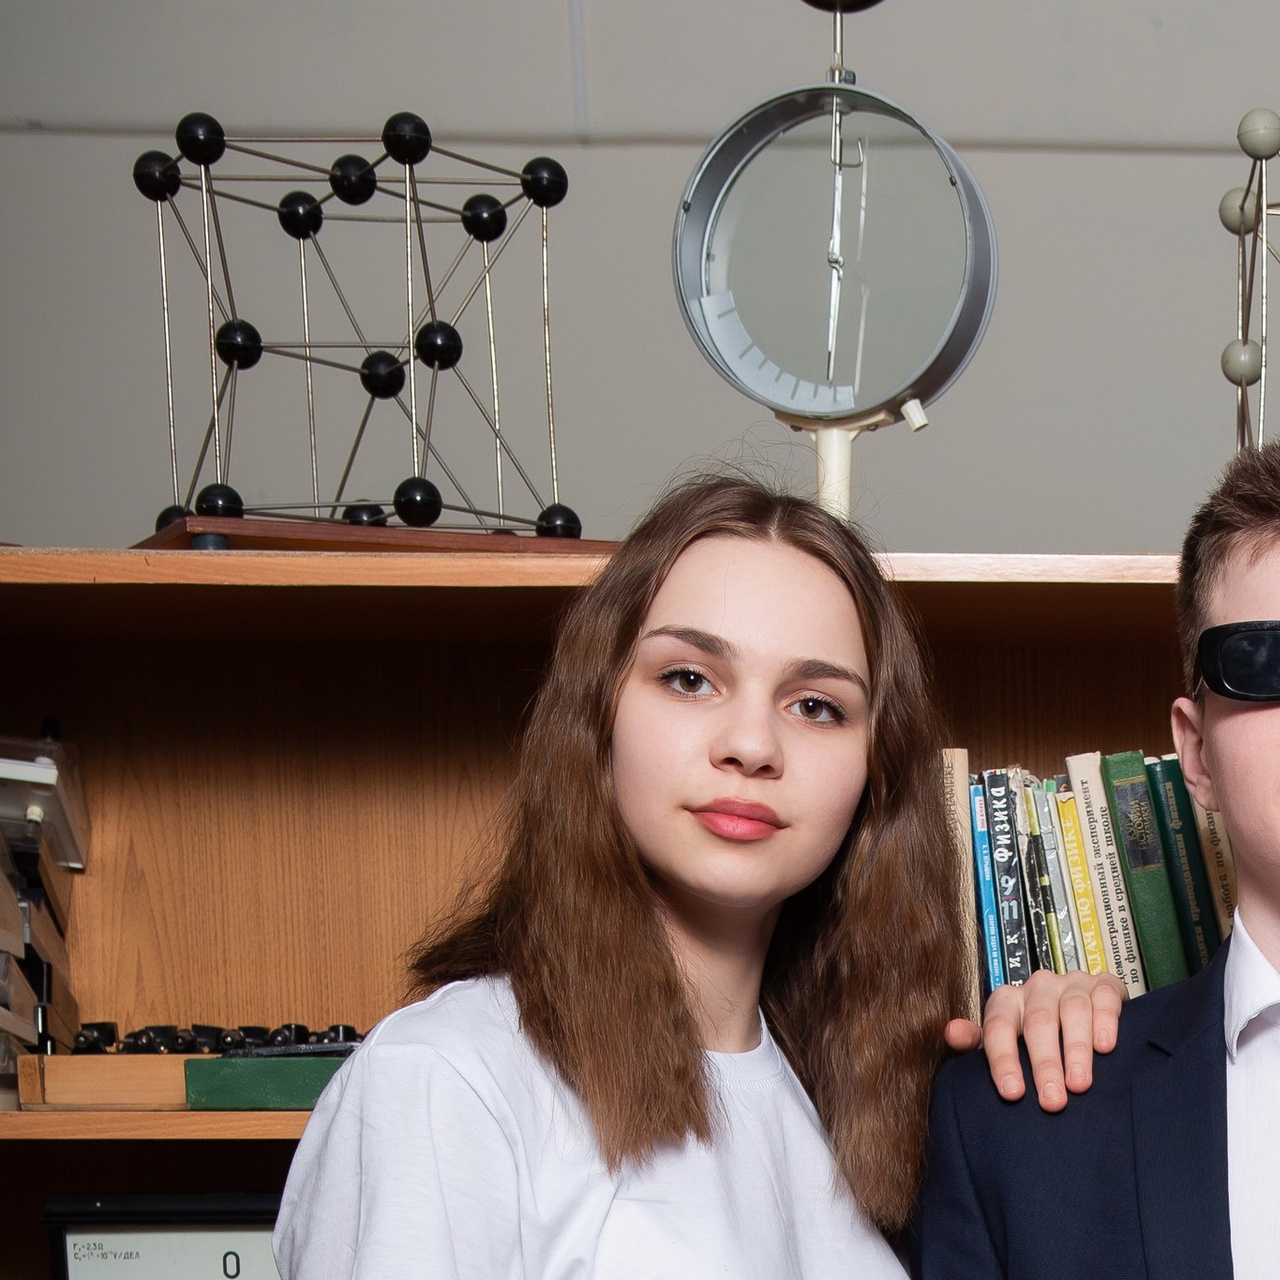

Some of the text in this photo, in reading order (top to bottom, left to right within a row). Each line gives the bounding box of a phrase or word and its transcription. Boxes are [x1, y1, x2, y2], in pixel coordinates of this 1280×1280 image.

[1080, 780, 1102, 858] эксперимент
[1063, 819, 1087, 892] ФИЗИКЕ
[1215, 852, 1224, 868] по
[1000, 875, 1016, 896] 9
[1100, 805, 1140, 984] по физике в средней школе
[1001, 900, 1018, 920] 11
[222, 1251, 240, 1279] 0
